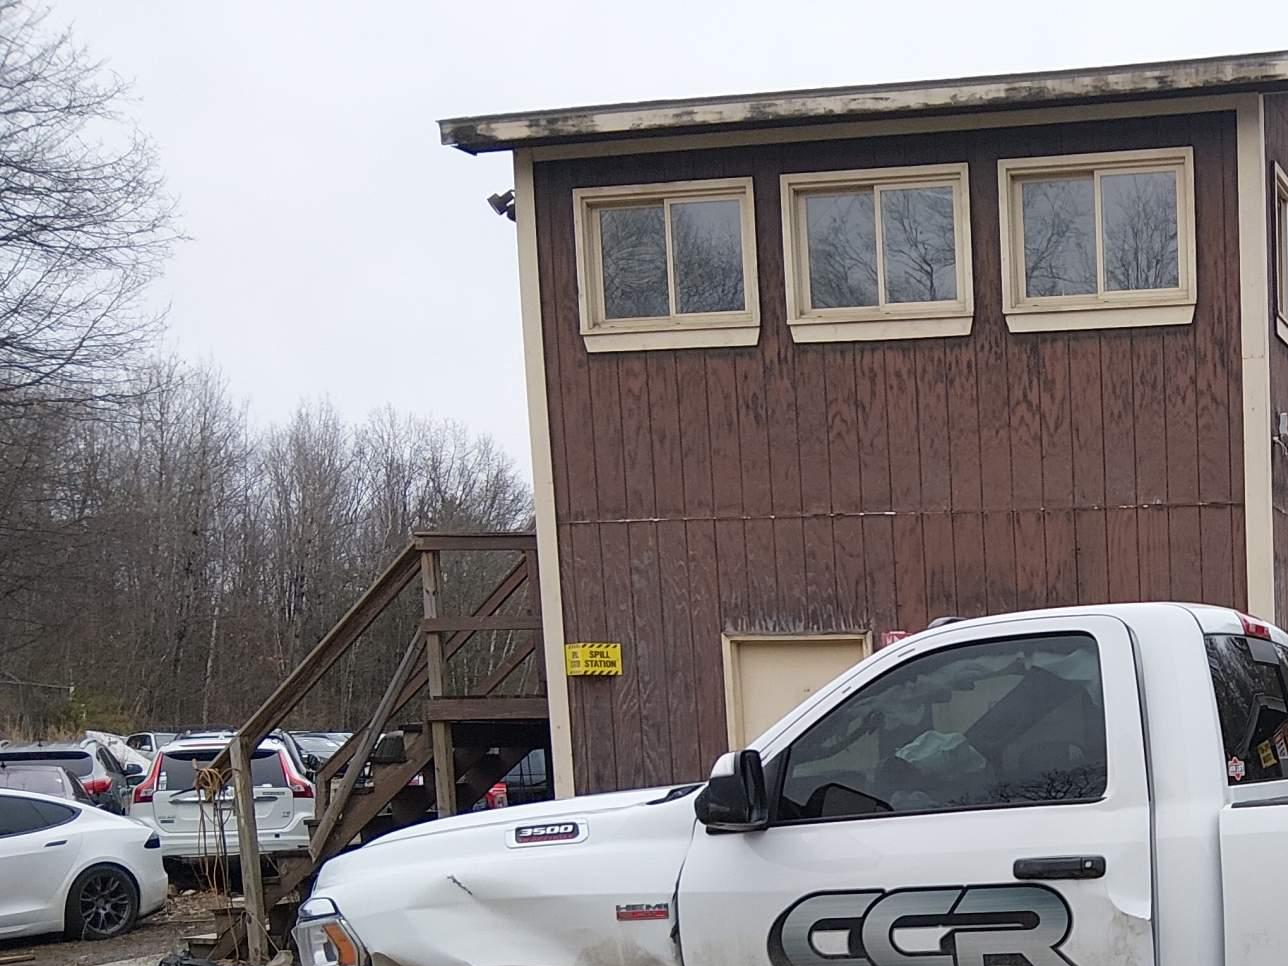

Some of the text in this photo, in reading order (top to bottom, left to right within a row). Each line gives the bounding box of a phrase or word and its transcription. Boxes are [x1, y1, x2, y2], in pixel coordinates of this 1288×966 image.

[589, 650, 611, 659] SPILL
[584, 660, 617, 668] STATION
[519, 824, 574, 837] 3500
[615, 902, 669, 912] HEMI
